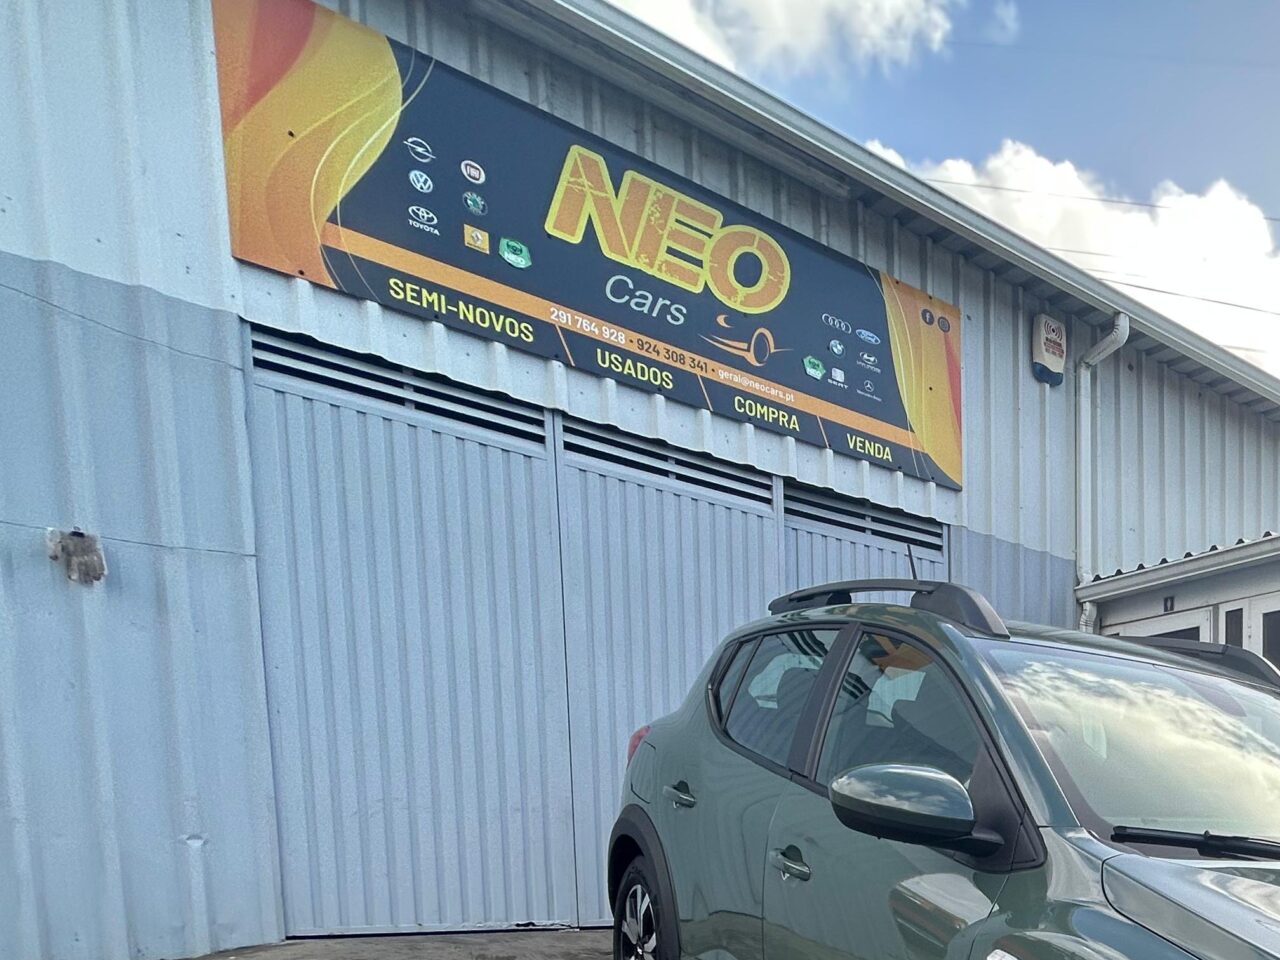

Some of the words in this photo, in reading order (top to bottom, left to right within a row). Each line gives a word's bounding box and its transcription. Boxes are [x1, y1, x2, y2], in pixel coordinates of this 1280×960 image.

[408, 219, 440, 236] TOYOTA
[544, 144, 791, 314] NEO
[389, 278, 534, 342] SEMI-NOVOS
[605, 274, 688, 326] Cars
[550, 308, 572, 325] 291
[576, 316, 599, 336] 764
[602, 326, 626, 344] 928
[636, 338, 660, 356] 924
[663, 347, 687, 365] 308
[689, 356, 709, 373] 341
[718, 368, 795, 402] geral@neocars.pt
[596, 348, 674, 389] USADOS
[734, 395, 800, 432] COMPRA
[846, 433, 893, 462] VENDA
